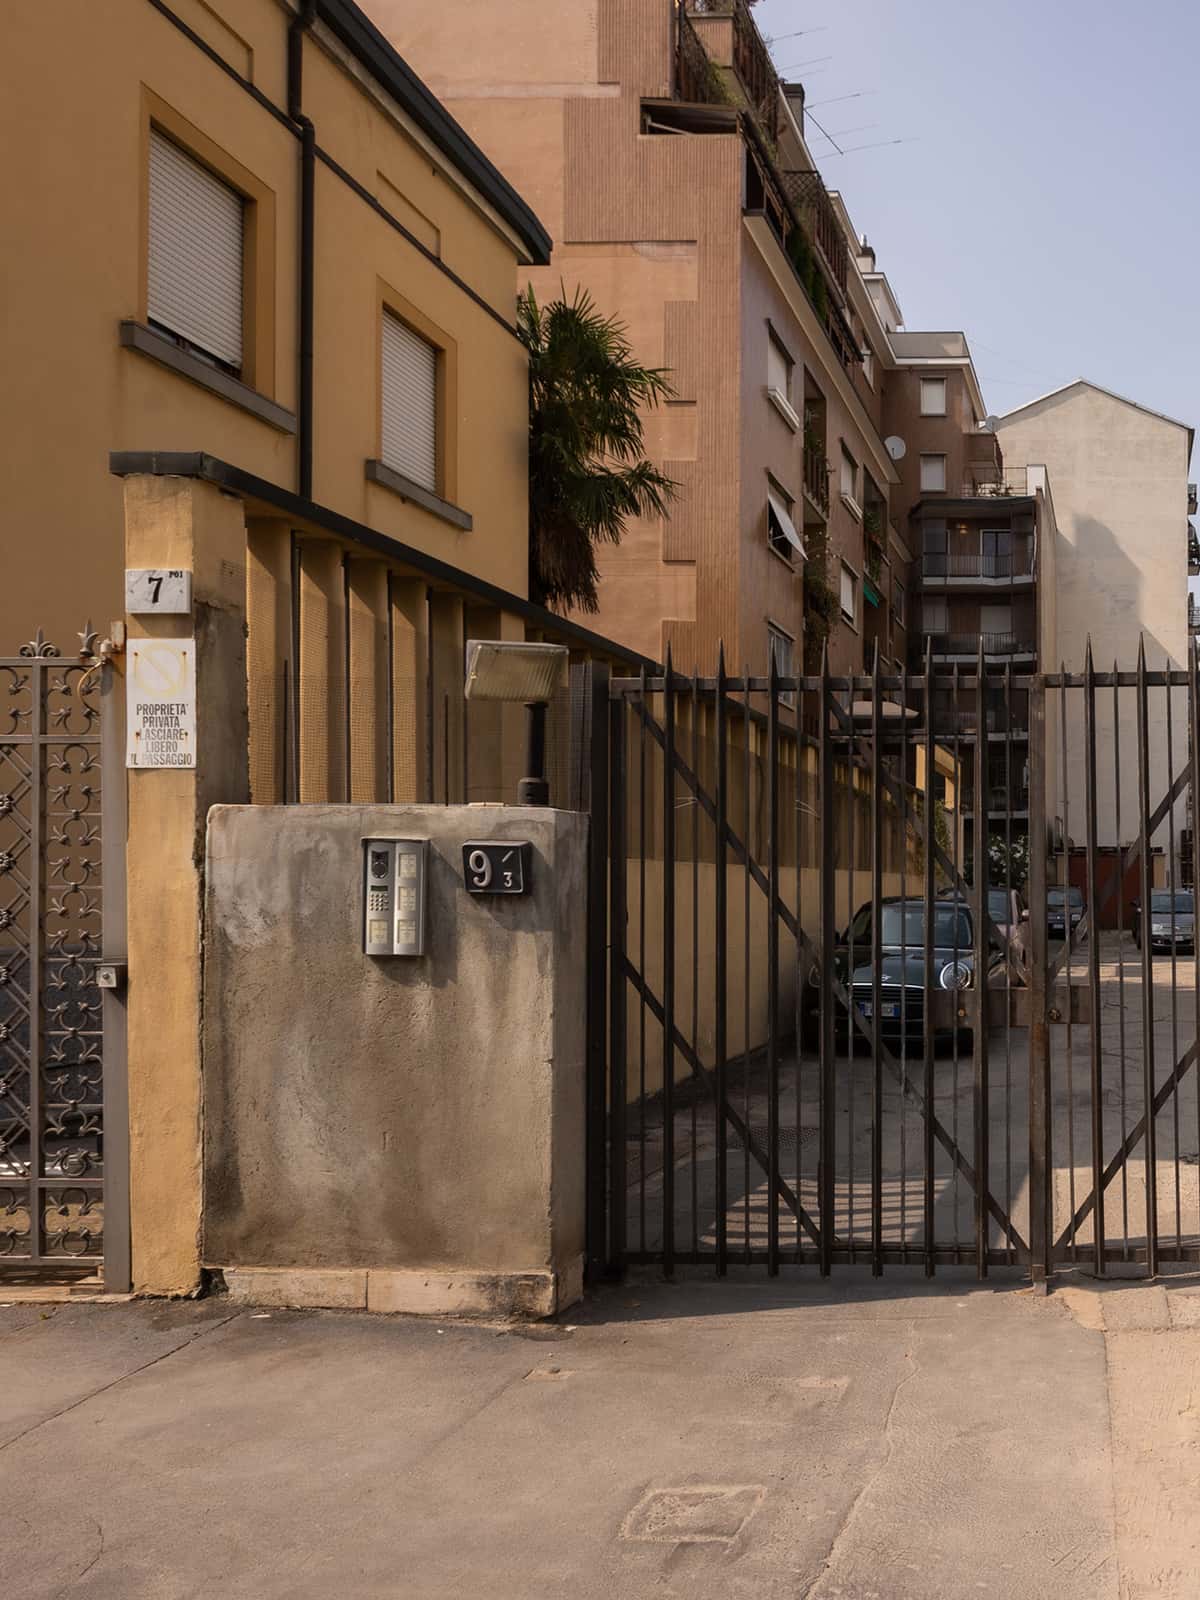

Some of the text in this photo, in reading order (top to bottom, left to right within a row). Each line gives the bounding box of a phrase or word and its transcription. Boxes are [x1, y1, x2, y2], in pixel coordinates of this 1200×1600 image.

[148, 576, 163, 604] 7
[142, 716, 180, 728] PRIVATA
[145, 741, 178, 753] LIBERO
